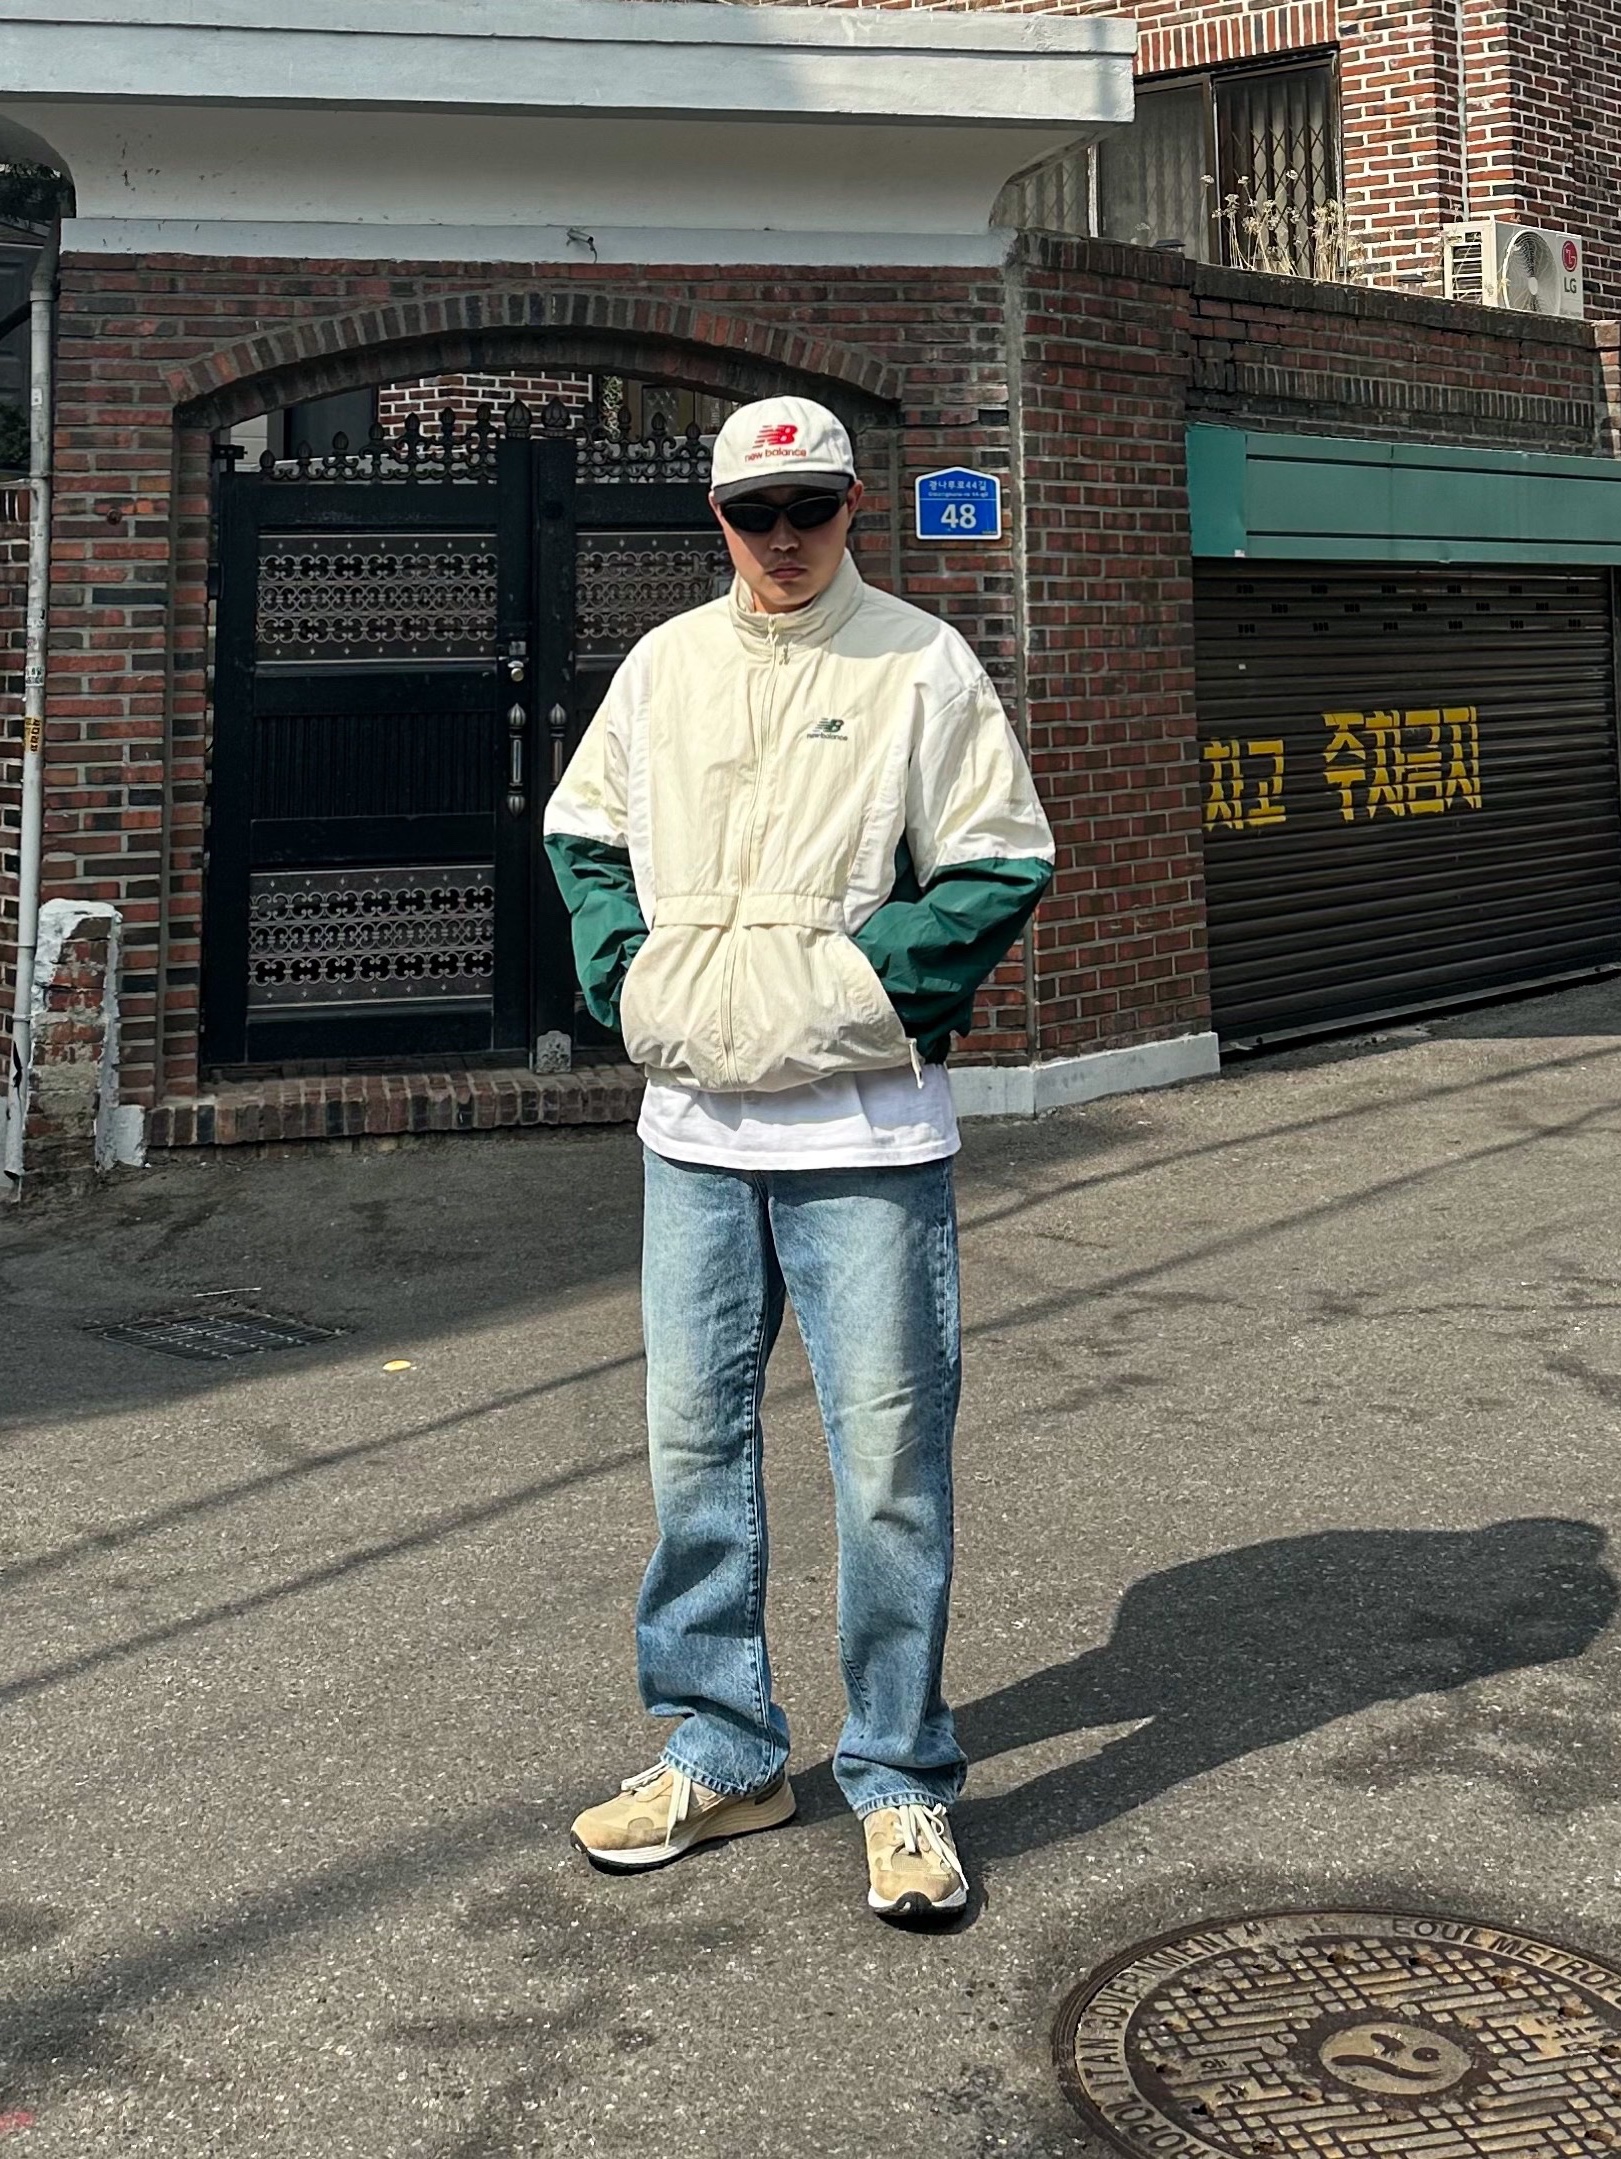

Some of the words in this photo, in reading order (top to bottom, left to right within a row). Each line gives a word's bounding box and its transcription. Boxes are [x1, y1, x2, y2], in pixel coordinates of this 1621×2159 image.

[1563, 276, 1577, 294] LG
[744, 451, 763, 463] new
[765, 447, 808, 458] balance
[940, 503, 977, 529] 48
[820, 732, 848, 741] balance
[1321, 705, 1483, 822] 주차금지
[1391, 1918, 1482, 1947] EOUL
[1488, 1936, 1621, 2004] METRO
[1079, 2037, 1228, 2159] ROPOLITAN
